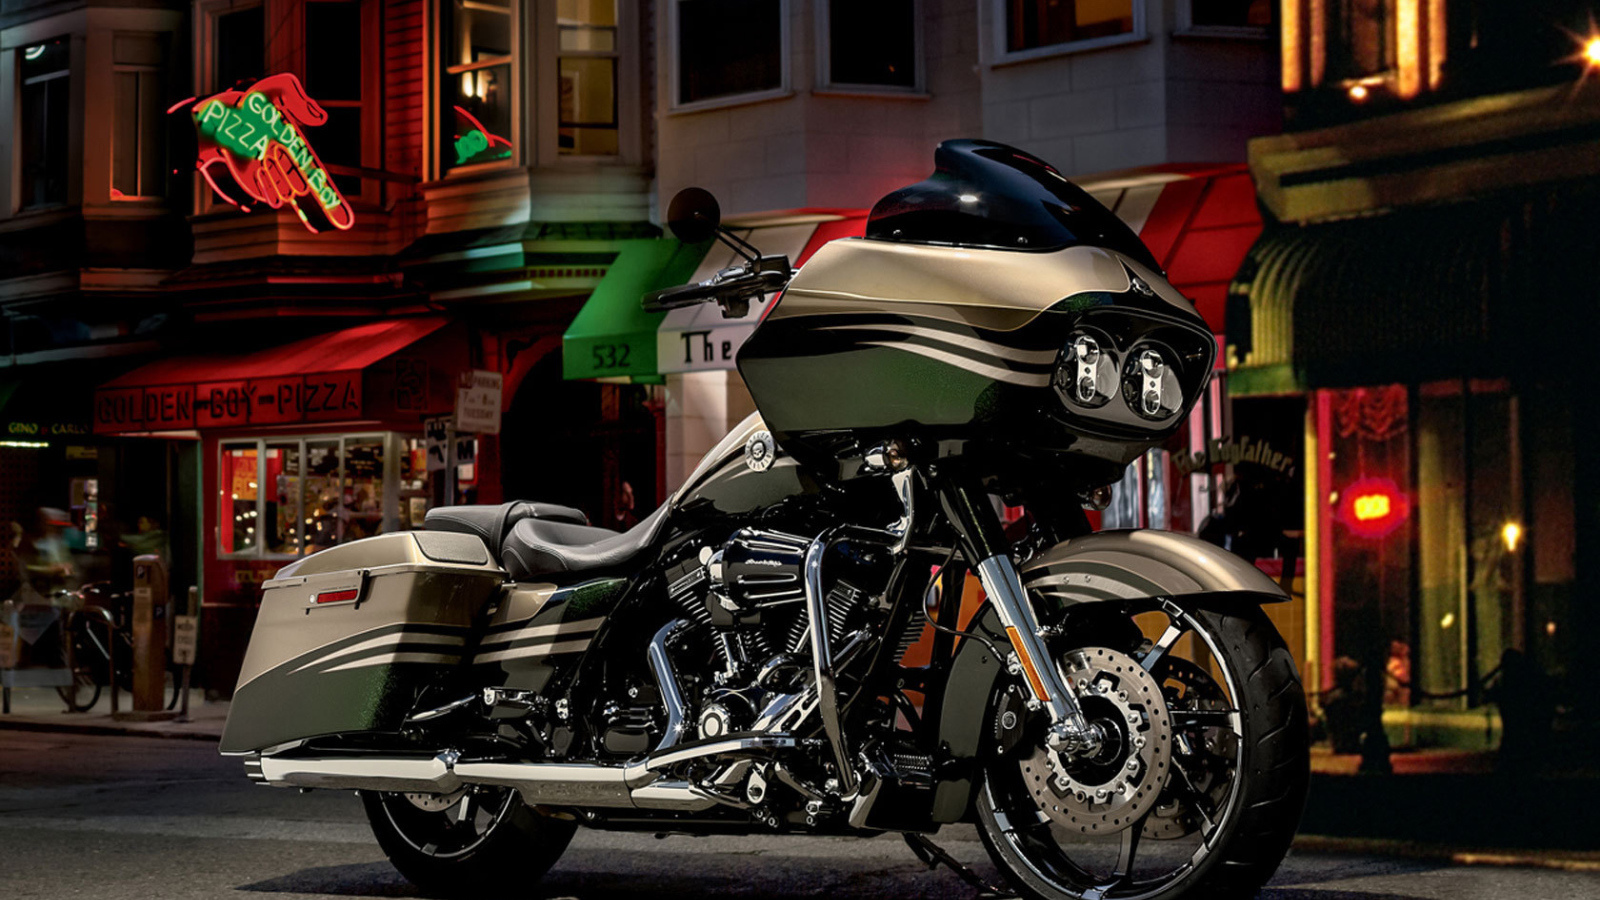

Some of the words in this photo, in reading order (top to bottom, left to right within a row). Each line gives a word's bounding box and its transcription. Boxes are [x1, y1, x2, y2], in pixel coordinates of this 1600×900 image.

[203, 100, 269, 160] PIZZA
[248, 93, 313, 169] GOLDEN
[308, 168, 341, 208] BOY
[592, 343, 631, 369] 532
[680, 330, 732, 364] The
[8, 421, 39, 435] GINO
